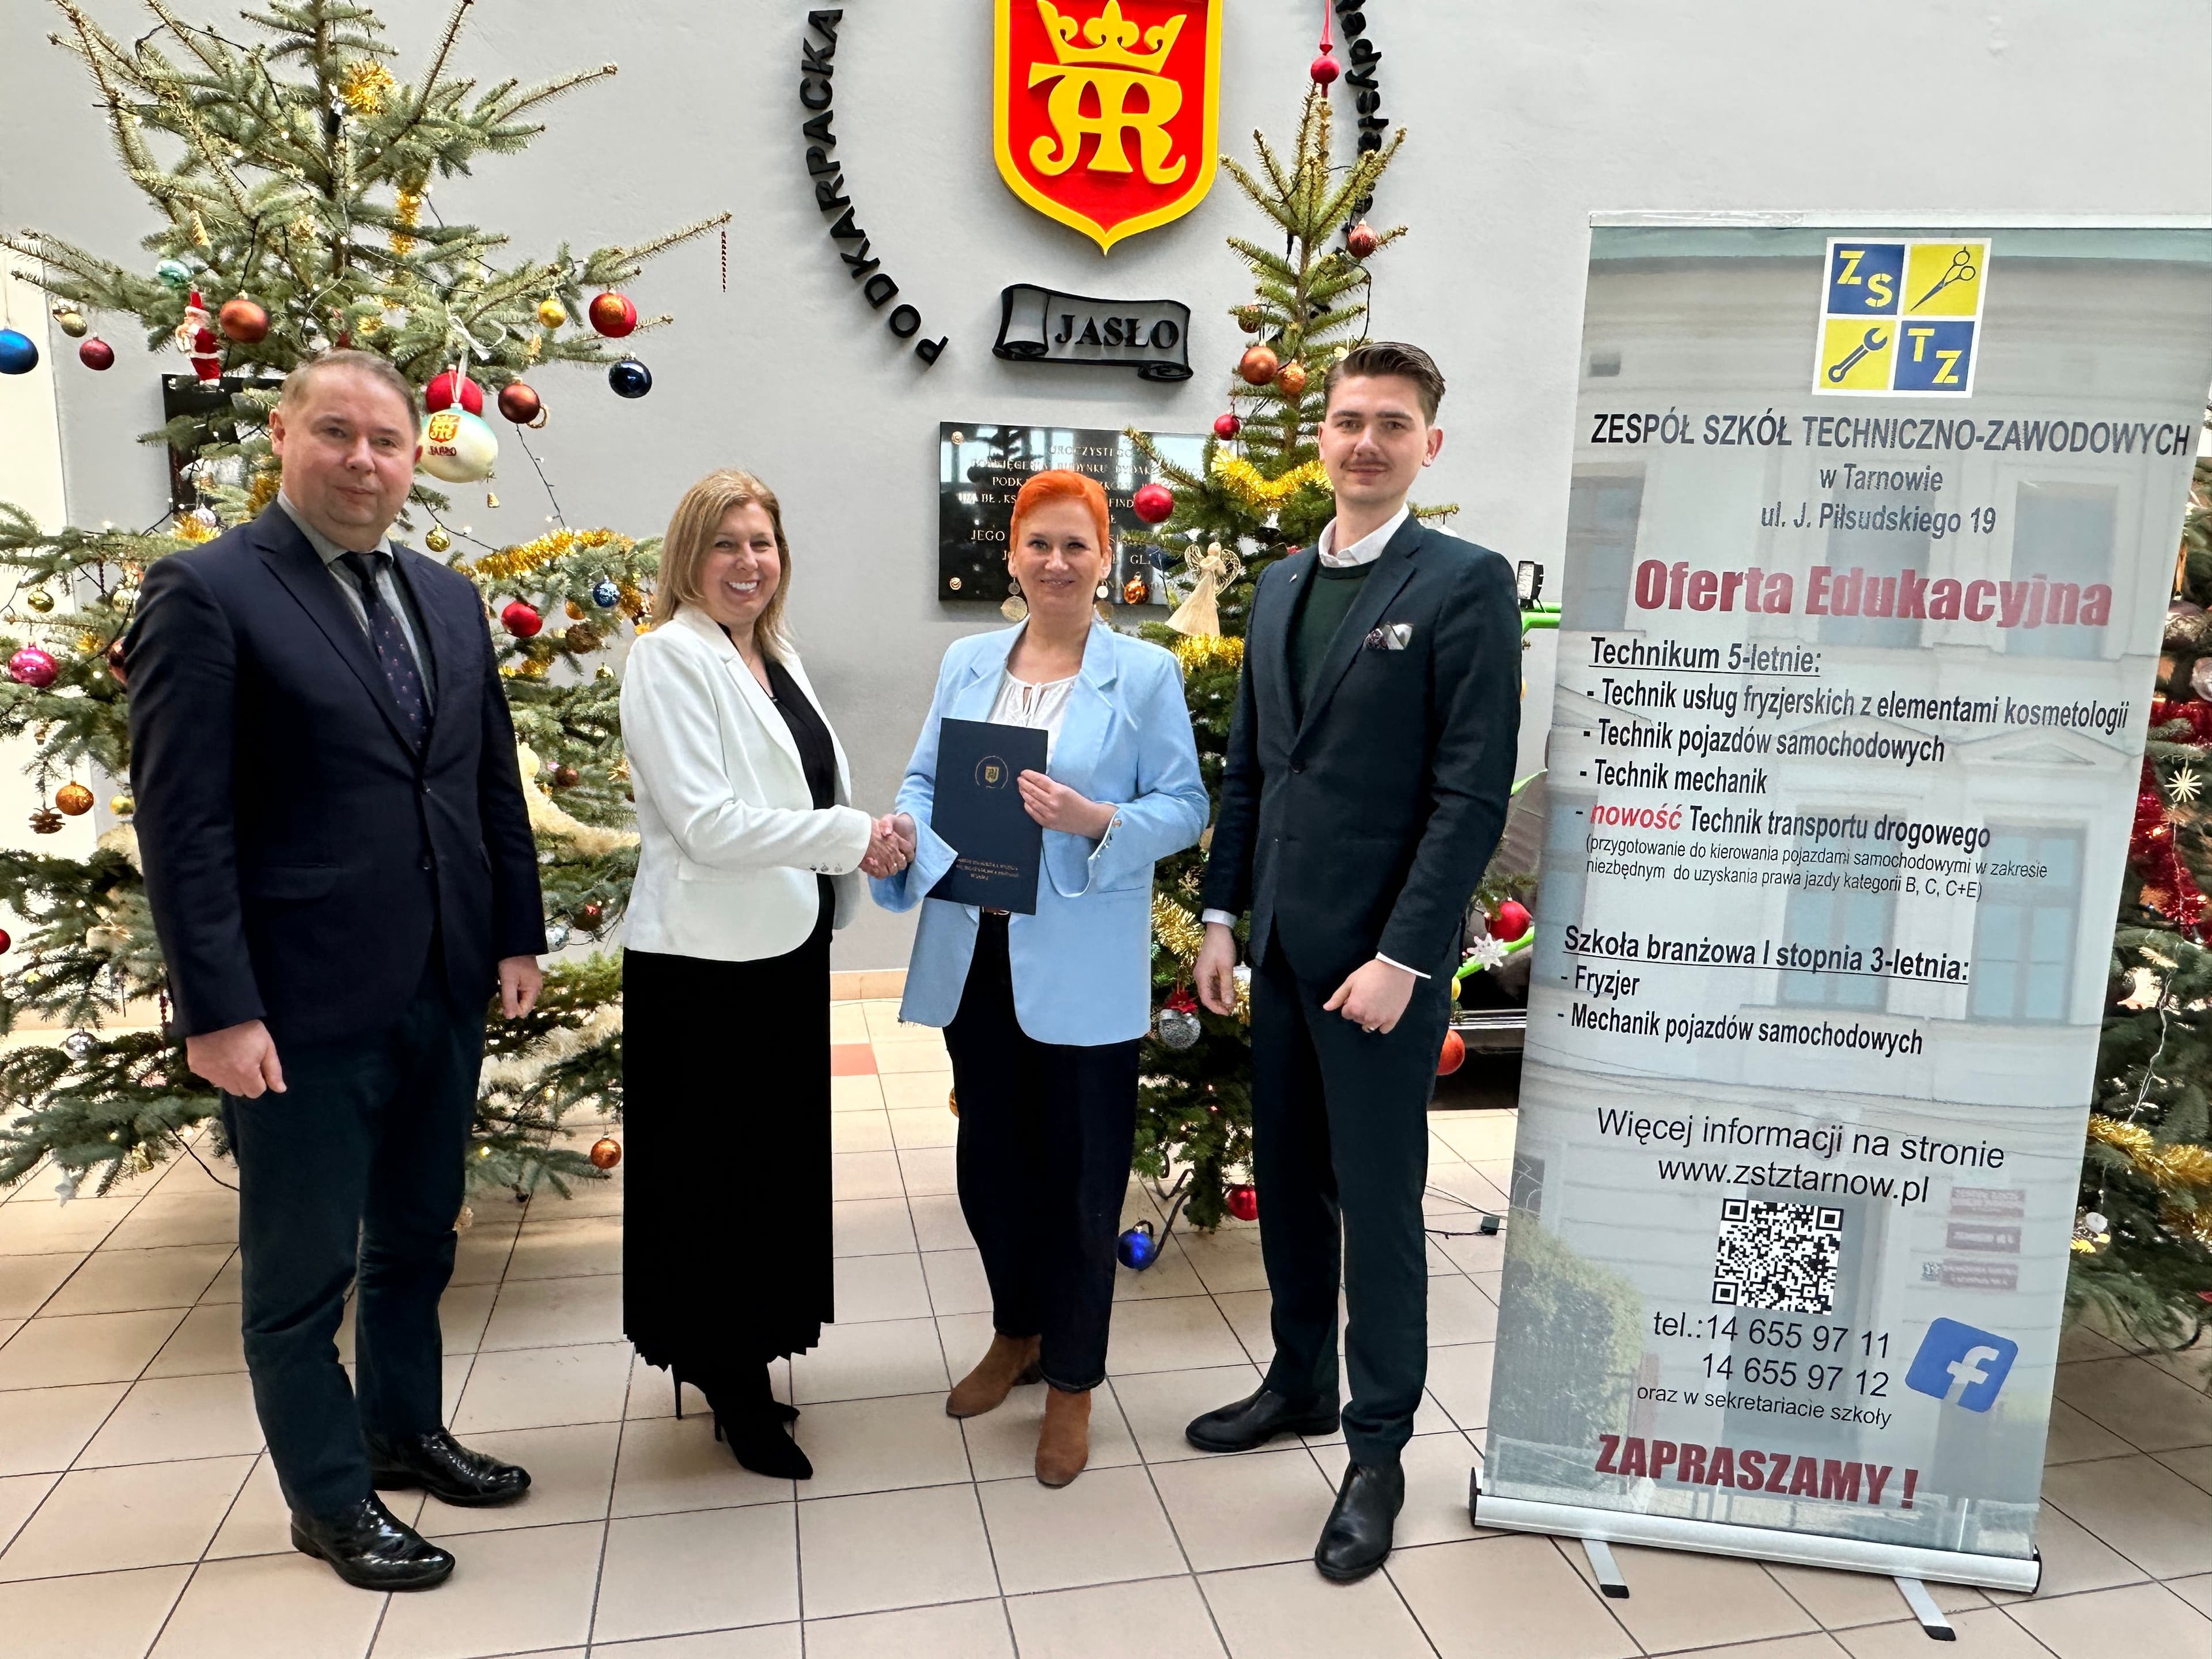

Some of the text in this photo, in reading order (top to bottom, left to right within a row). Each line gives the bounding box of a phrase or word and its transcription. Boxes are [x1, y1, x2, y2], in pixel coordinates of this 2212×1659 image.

[800, 9, 949, 367] PODKARPACKA
[1055, 315, 1179, 349] JASŁO
[1591, 408, 2191, 456] ZESPÓŁ SZKÓŁ TECHNICZNO-ZAWODOWYCH
[1820, 463, 1943, 492] w Tarnowie
[971, 530, 1005, 540] JEGO
[1762, 503, 1995, 539] ul. J. Piłsudskiego 19
[1634, 559, 2112, 628] Oferta Edukacyjna
[1591, 637, 1821, 673] Technikum 5-letnie:
[1602, 679, 1677, 708] Technik
[1683, 683, 1738, 718] usług
[1744, 687, 1856, 719] fryzjerskich
[1861, 697, 1872, 716] z
[1877, 691, 1998, 723] elementami
[2004, 696, 2129, 736] kosmetologii
[1599, 718, 1673, 748] Technik
[1677, 724, 1772, 757] pojazdów
[1776, 730, 1945, 767] samochodowych
[1594, 759, 1669, 789] Technik
[1674, 766, 1768, 794] mechanik
[1590, 803, 1682, 830] nowość
[1690, 805, 1762, 835] Technik
[1767, 812, 1868, 843] transportu
[1874, 815, 1990, 853] drogowego
[1586, 835, 2047, 878] (przygotowanie do kierowania pojazdami samochodowymi w zakresie
[1587, 859, 1982, 902] niezbędnym do uzyskania prawa jazdy kategorii B, C, C+E)
[1565, 926, 1969, 980] Szkoła branżowa I stopnia 3-letnia:
[1574, 965, 1640, 1001] Fryzjer
[1571, 1003, 1660, 1036] Mechanik
[1665, 1013, 1753, 1044] pojazdów
[1758, 1021, 1922, 1055] samochodowych
[1598, 1107, 2004, 1168] Więcej informacji na stronie
[1658, 1158, 1929, 1206] www.zstztarnow.pl
[1653, 1310, 1888, 1358] tel.:14 655 97 11
[1703, 1353, 1889, 1397] 14 655 97 12
[1637, 1387, 1892, 1429] oraz w sekretariacie szkoły
[1595, 1434, 1893, 1505] ZAPRASZAMY
